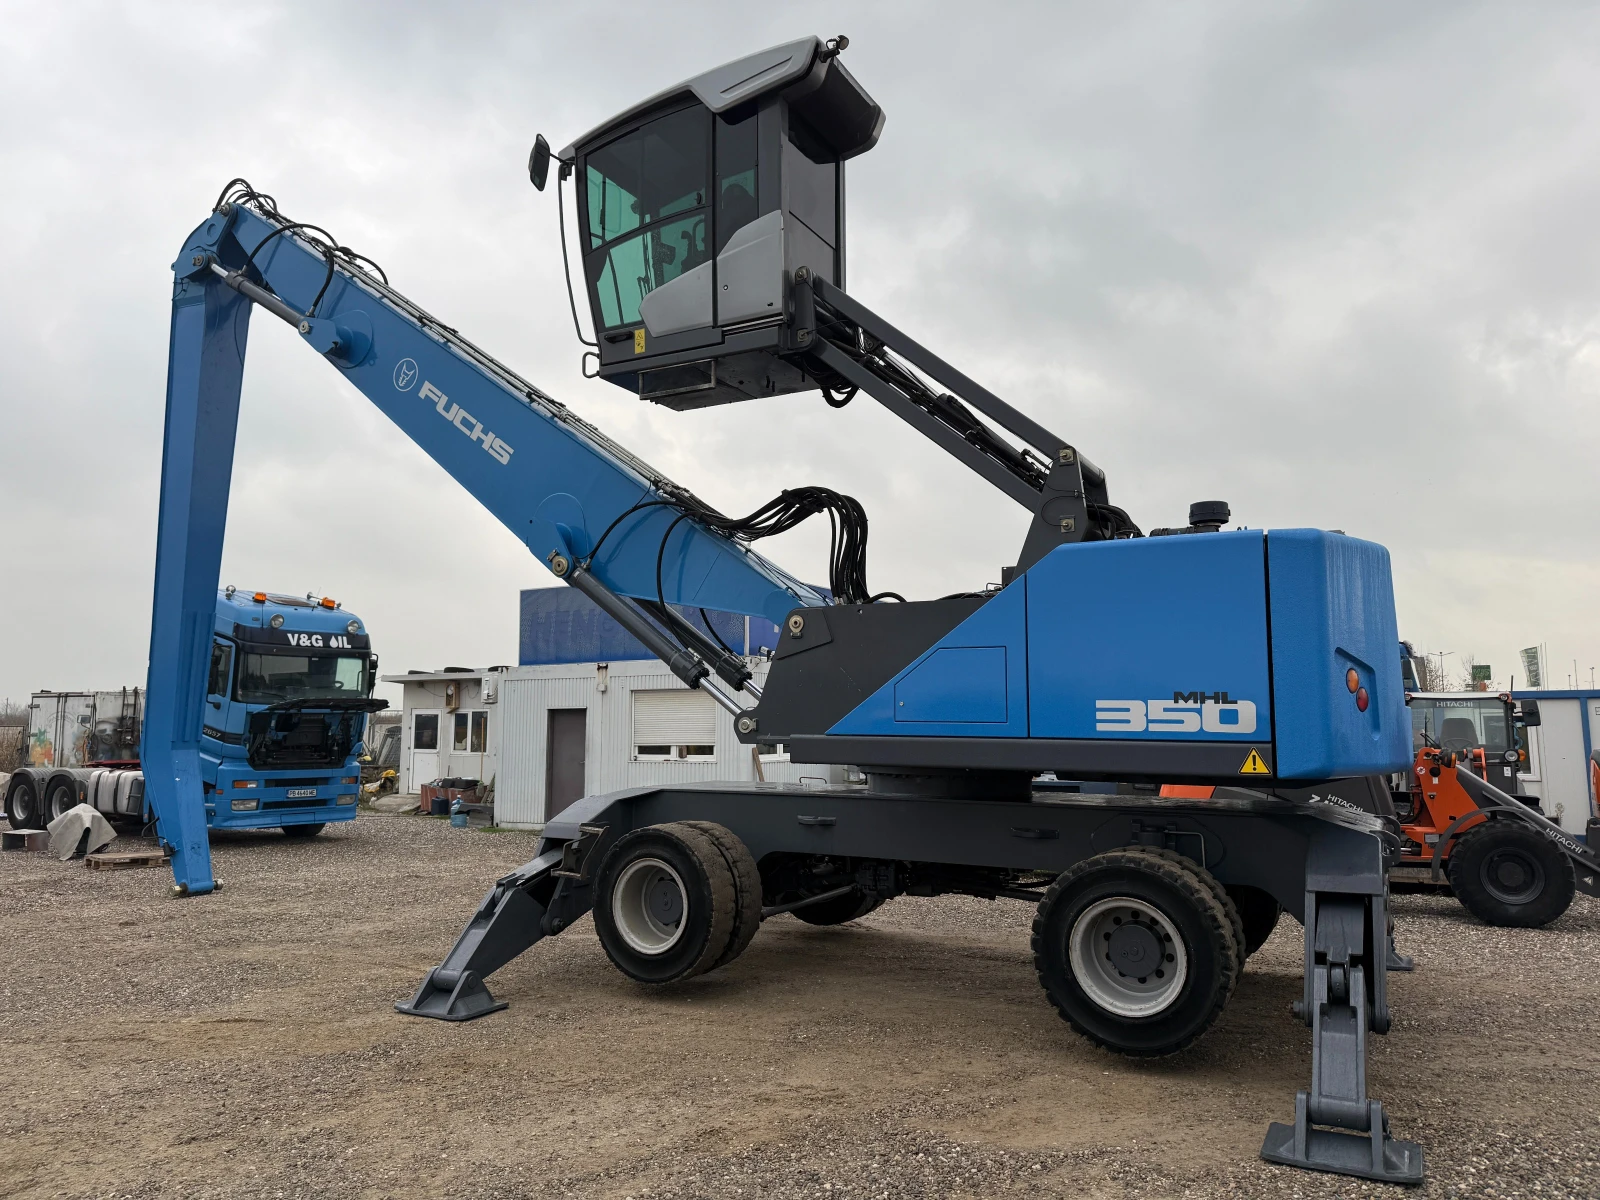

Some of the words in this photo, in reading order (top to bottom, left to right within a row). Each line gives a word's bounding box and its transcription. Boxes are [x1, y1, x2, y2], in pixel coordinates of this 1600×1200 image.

[418, 380, 515, 466] FUCHS
[287, 633, 323, 648] V&G
[1173, 691, 1238, 705] MHL
[1095, 699, 1257, 734] 350
[1327, 794, 1364, 813] HITACHI
[1546, 827, 1583, 854] HITACHI
